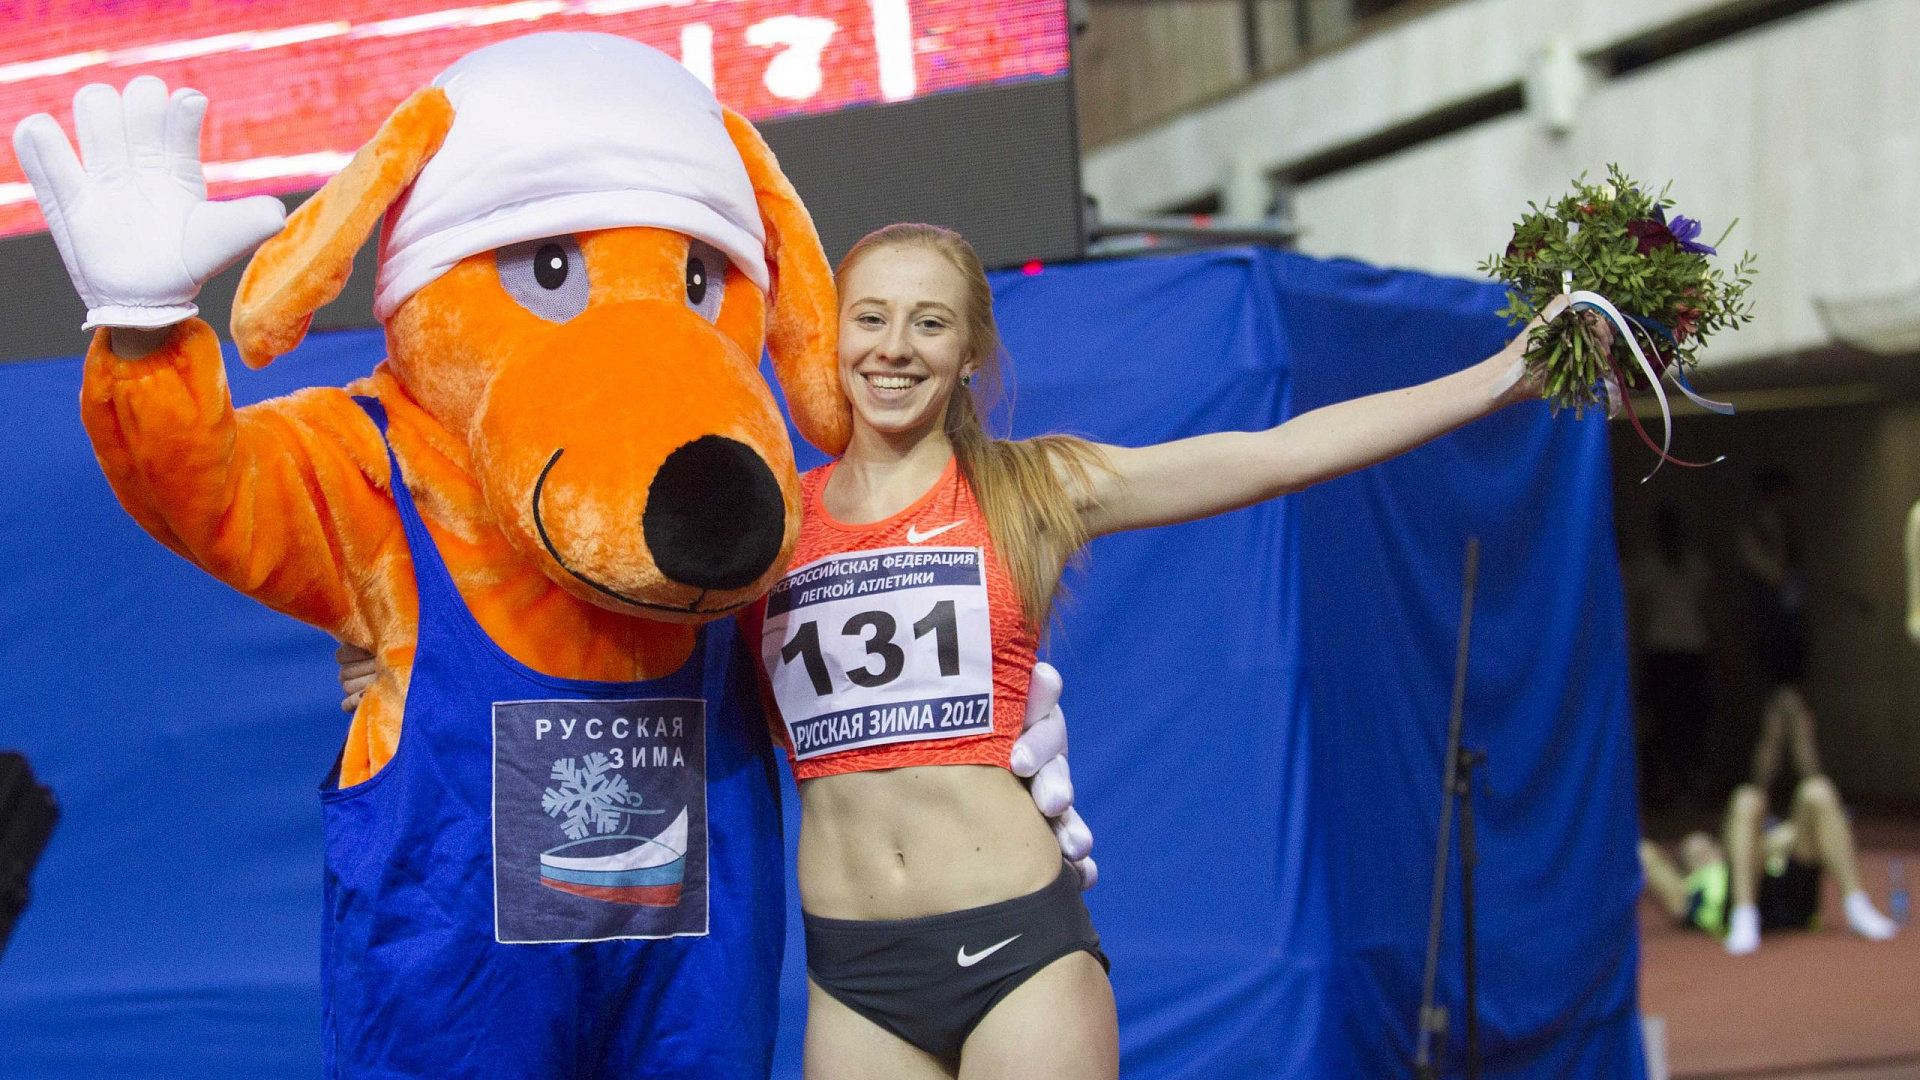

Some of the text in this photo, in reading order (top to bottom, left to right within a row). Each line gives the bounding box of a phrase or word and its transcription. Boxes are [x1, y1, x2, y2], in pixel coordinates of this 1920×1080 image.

[770, 553, 975, 597] ВСЕРОССИЙСКАЯ ФЕДЕРАЦИЯ
[798, 572, 934, 604] ЛЕГКОЙ АТЛЕТИКИ
[781, 600, 960, 696] 131
[535, 716, 684, 740] РУССКАЯ
[797, 699, 988, 750] РУССКАЯ ЗИМА 2017
[609, 747, 685, 769] ЗИМА
